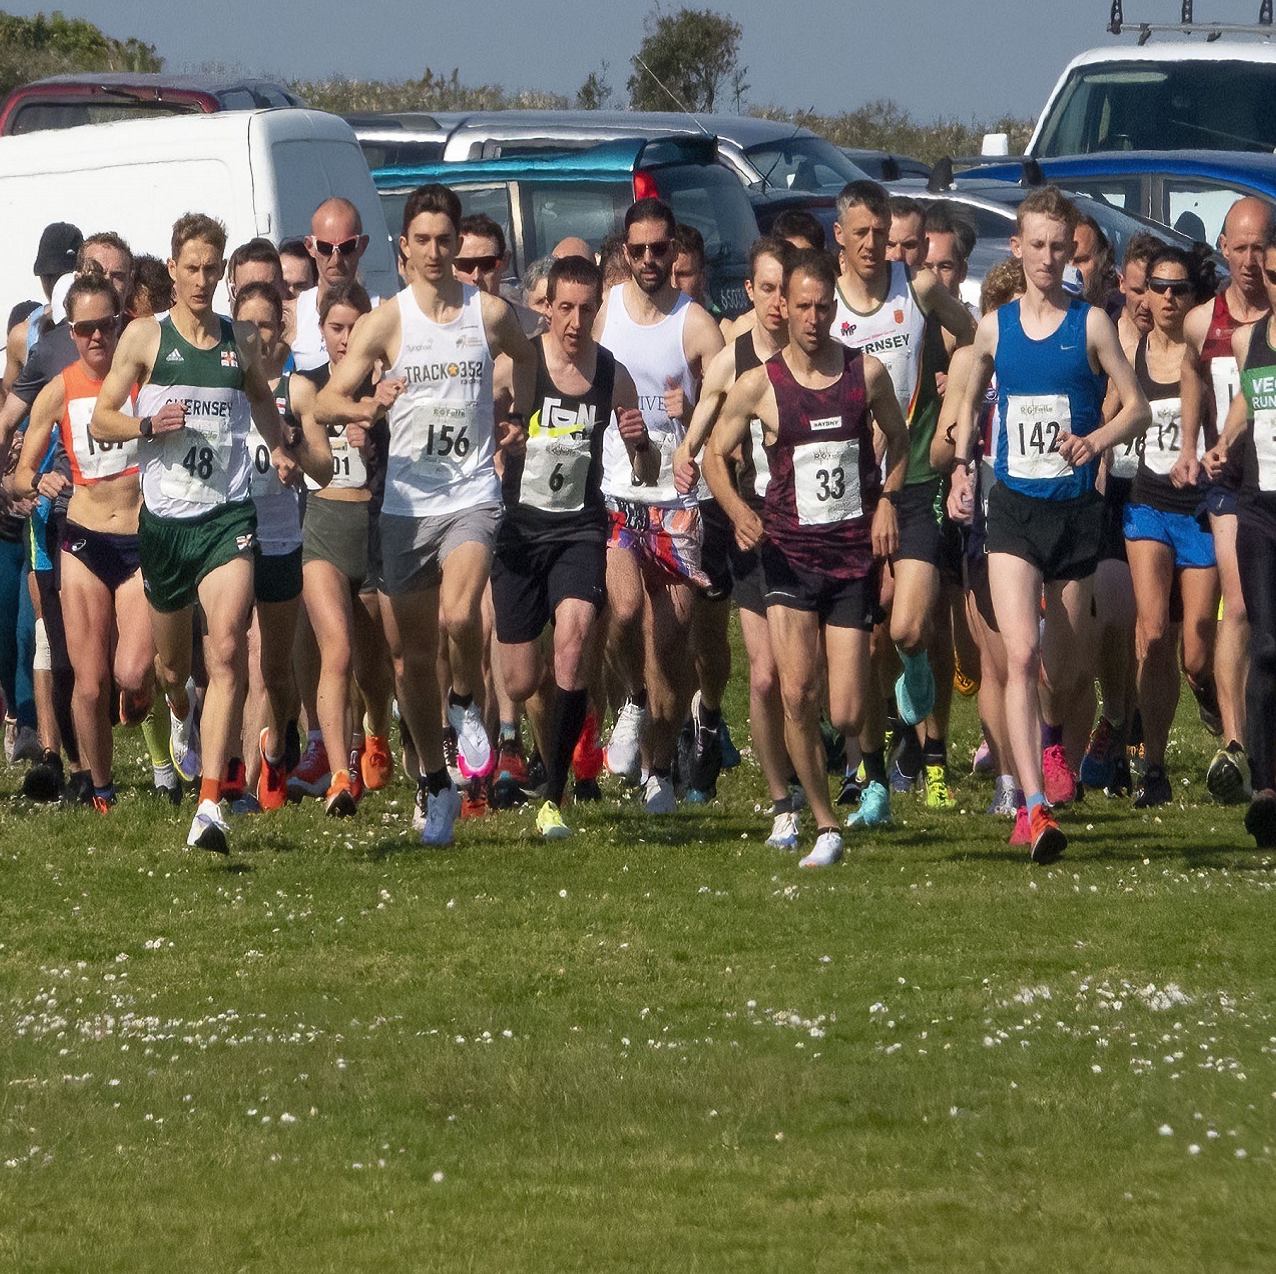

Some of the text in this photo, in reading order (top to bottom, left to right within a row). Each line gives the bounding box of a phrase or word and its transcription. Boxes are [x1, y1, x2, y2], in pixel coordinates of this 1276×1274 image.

[405, 361, 483, 384] TRACK 352
[427, 424, 470, 457] 156
[1018, 421, 1061, 456] 142
[183, 446, 214, 480] 48
[549, 463, 564, 492] 6
[816, 467, 845, 501] 33
